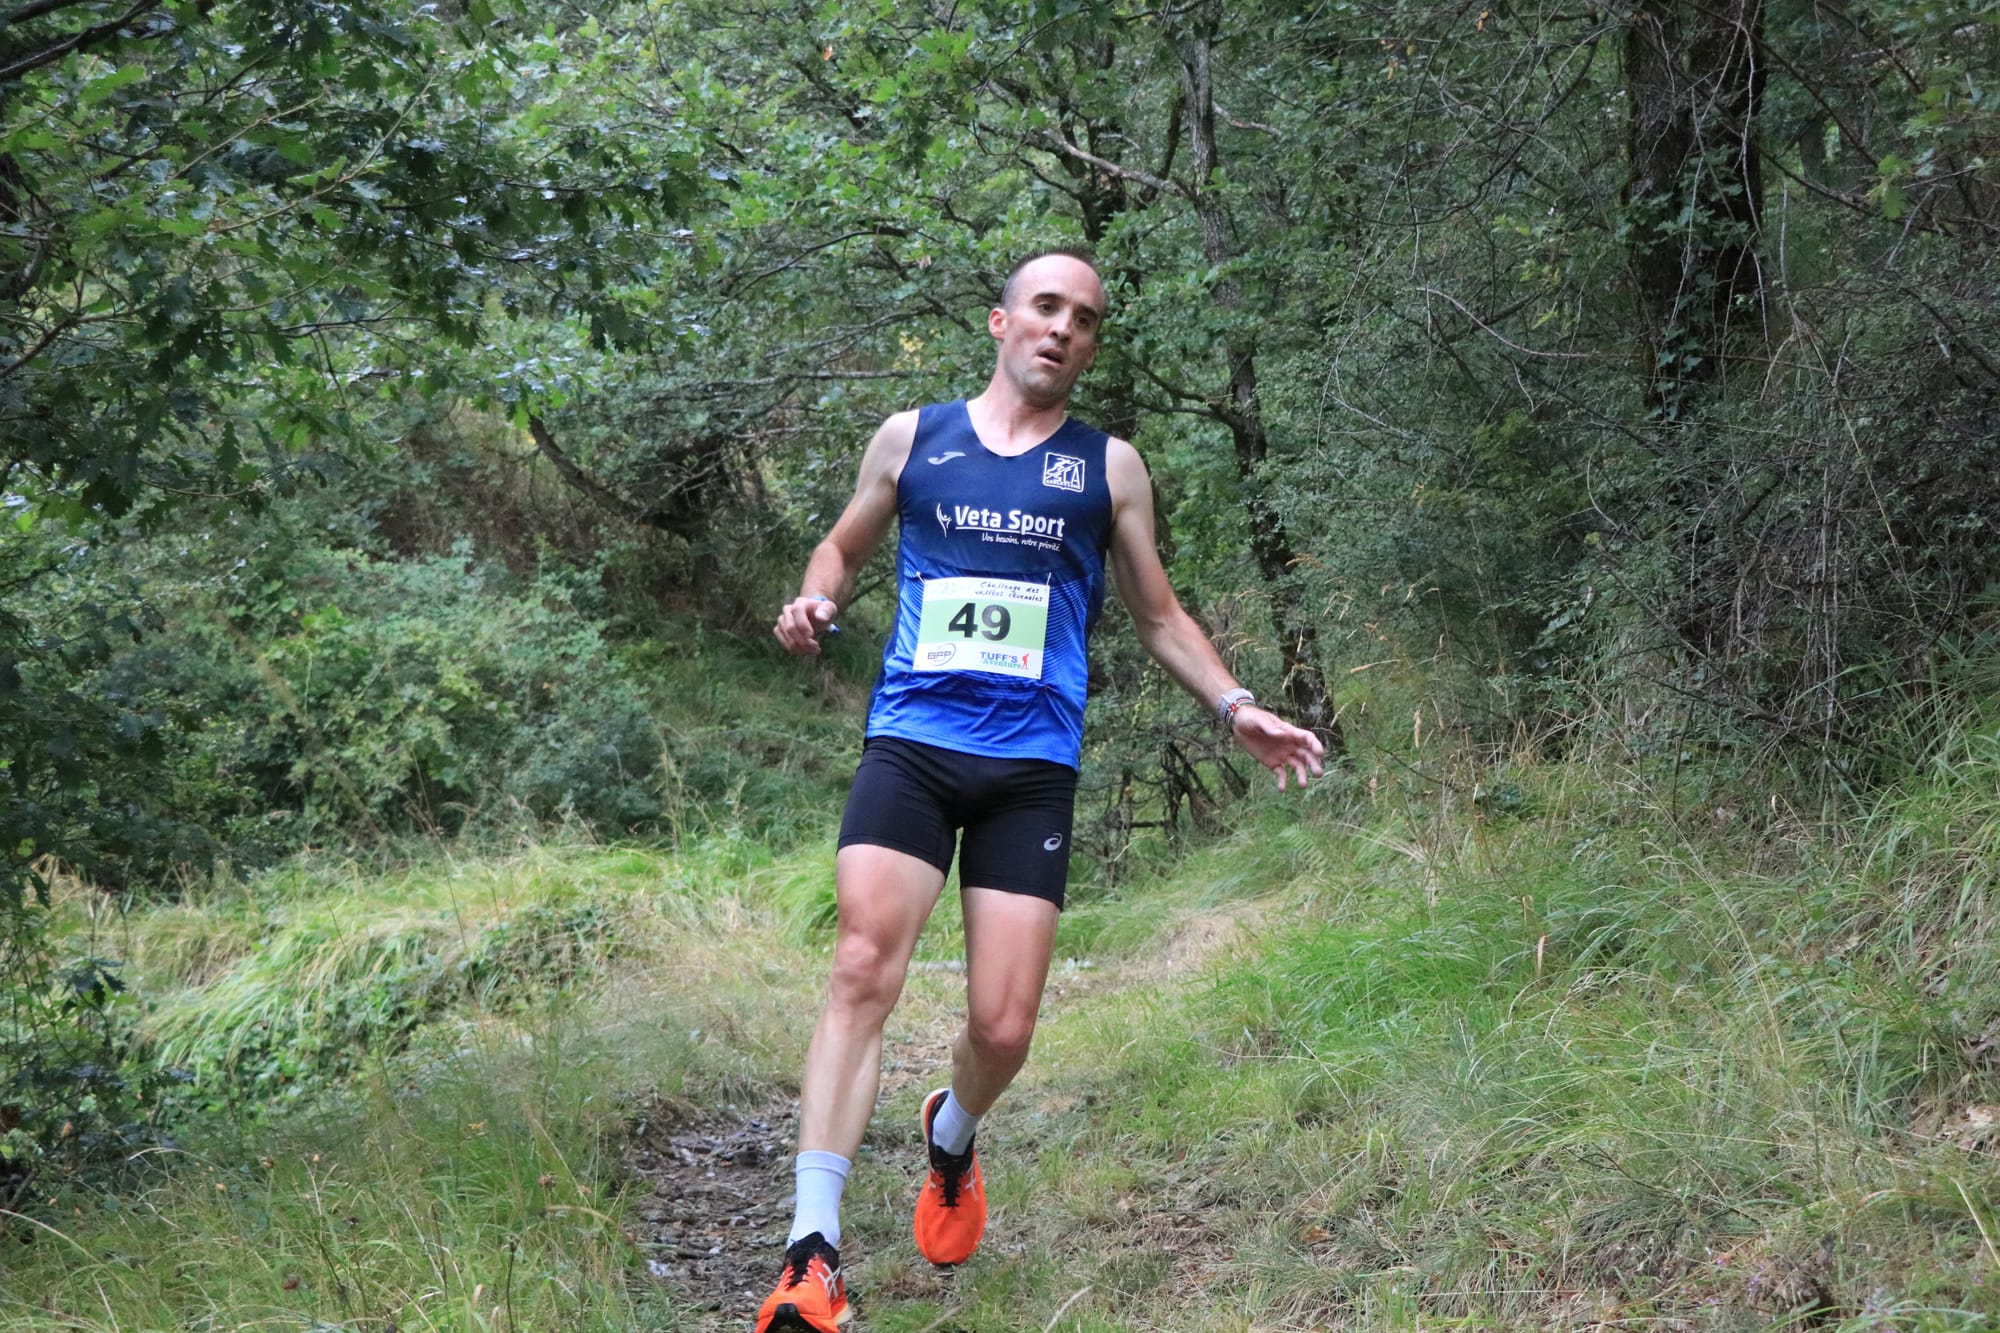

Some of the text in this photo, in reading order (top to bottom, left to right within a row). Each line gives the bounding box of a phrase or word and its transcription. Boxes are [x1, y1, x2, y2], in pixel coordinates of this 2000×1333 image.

[955, 505, 1065, 537] Veta Sport
[948, 602, 1011, 641] 49
[979, 651, 1018, 664] TUFF'S
